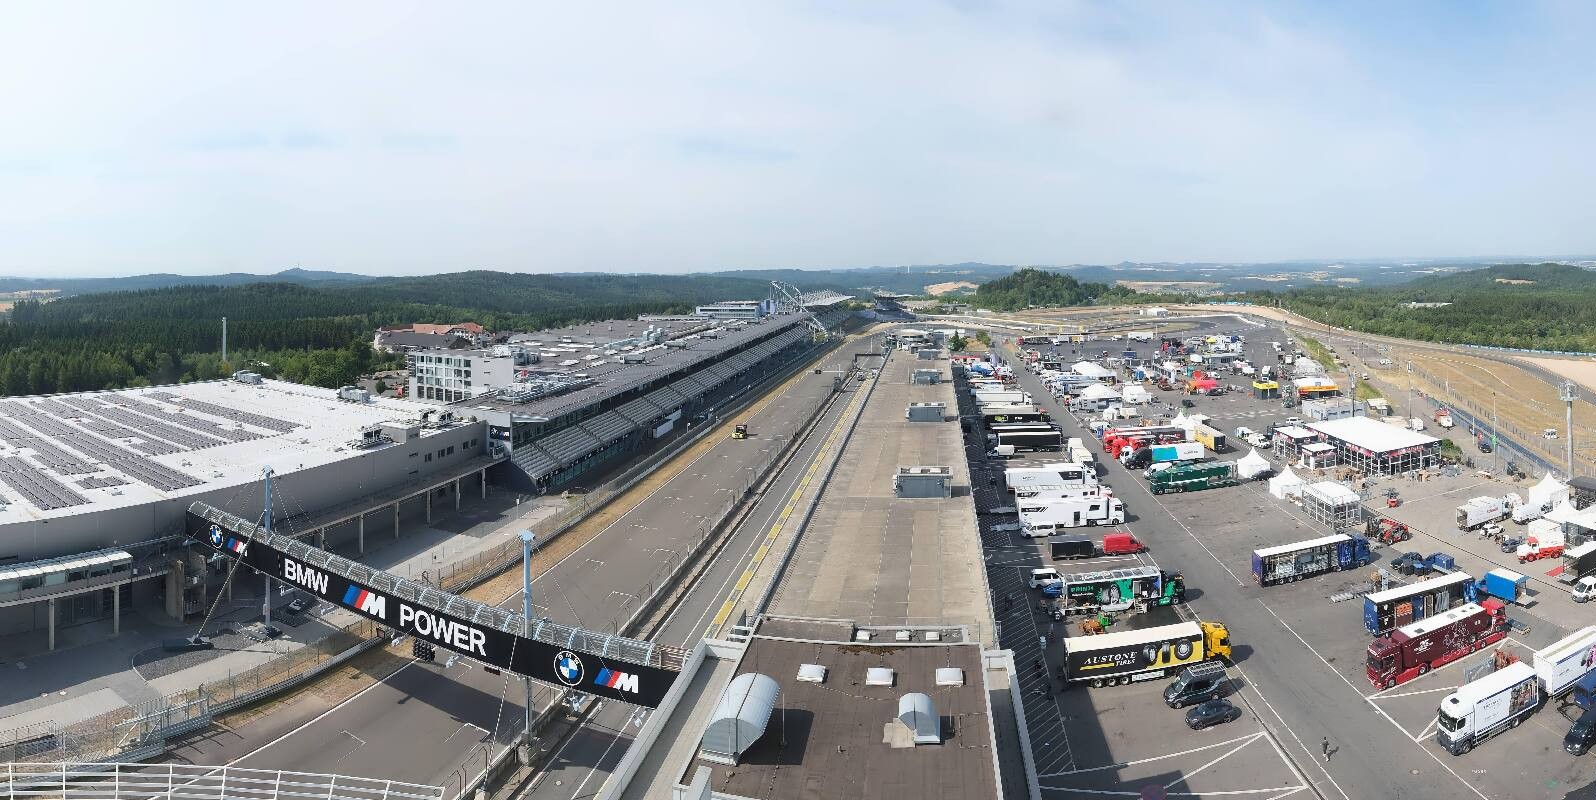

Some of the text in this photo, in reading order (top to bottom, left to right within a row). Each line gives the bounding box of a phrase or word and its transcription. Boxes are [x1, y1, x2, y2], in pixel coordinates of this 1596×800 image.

[284, 558, 487, 657] BMW M POWER
[1083, 651, 1138, 665] AUSTONE
[1115, 658, 1136, 667] TIRES
[615, 671, 639, 694] M
